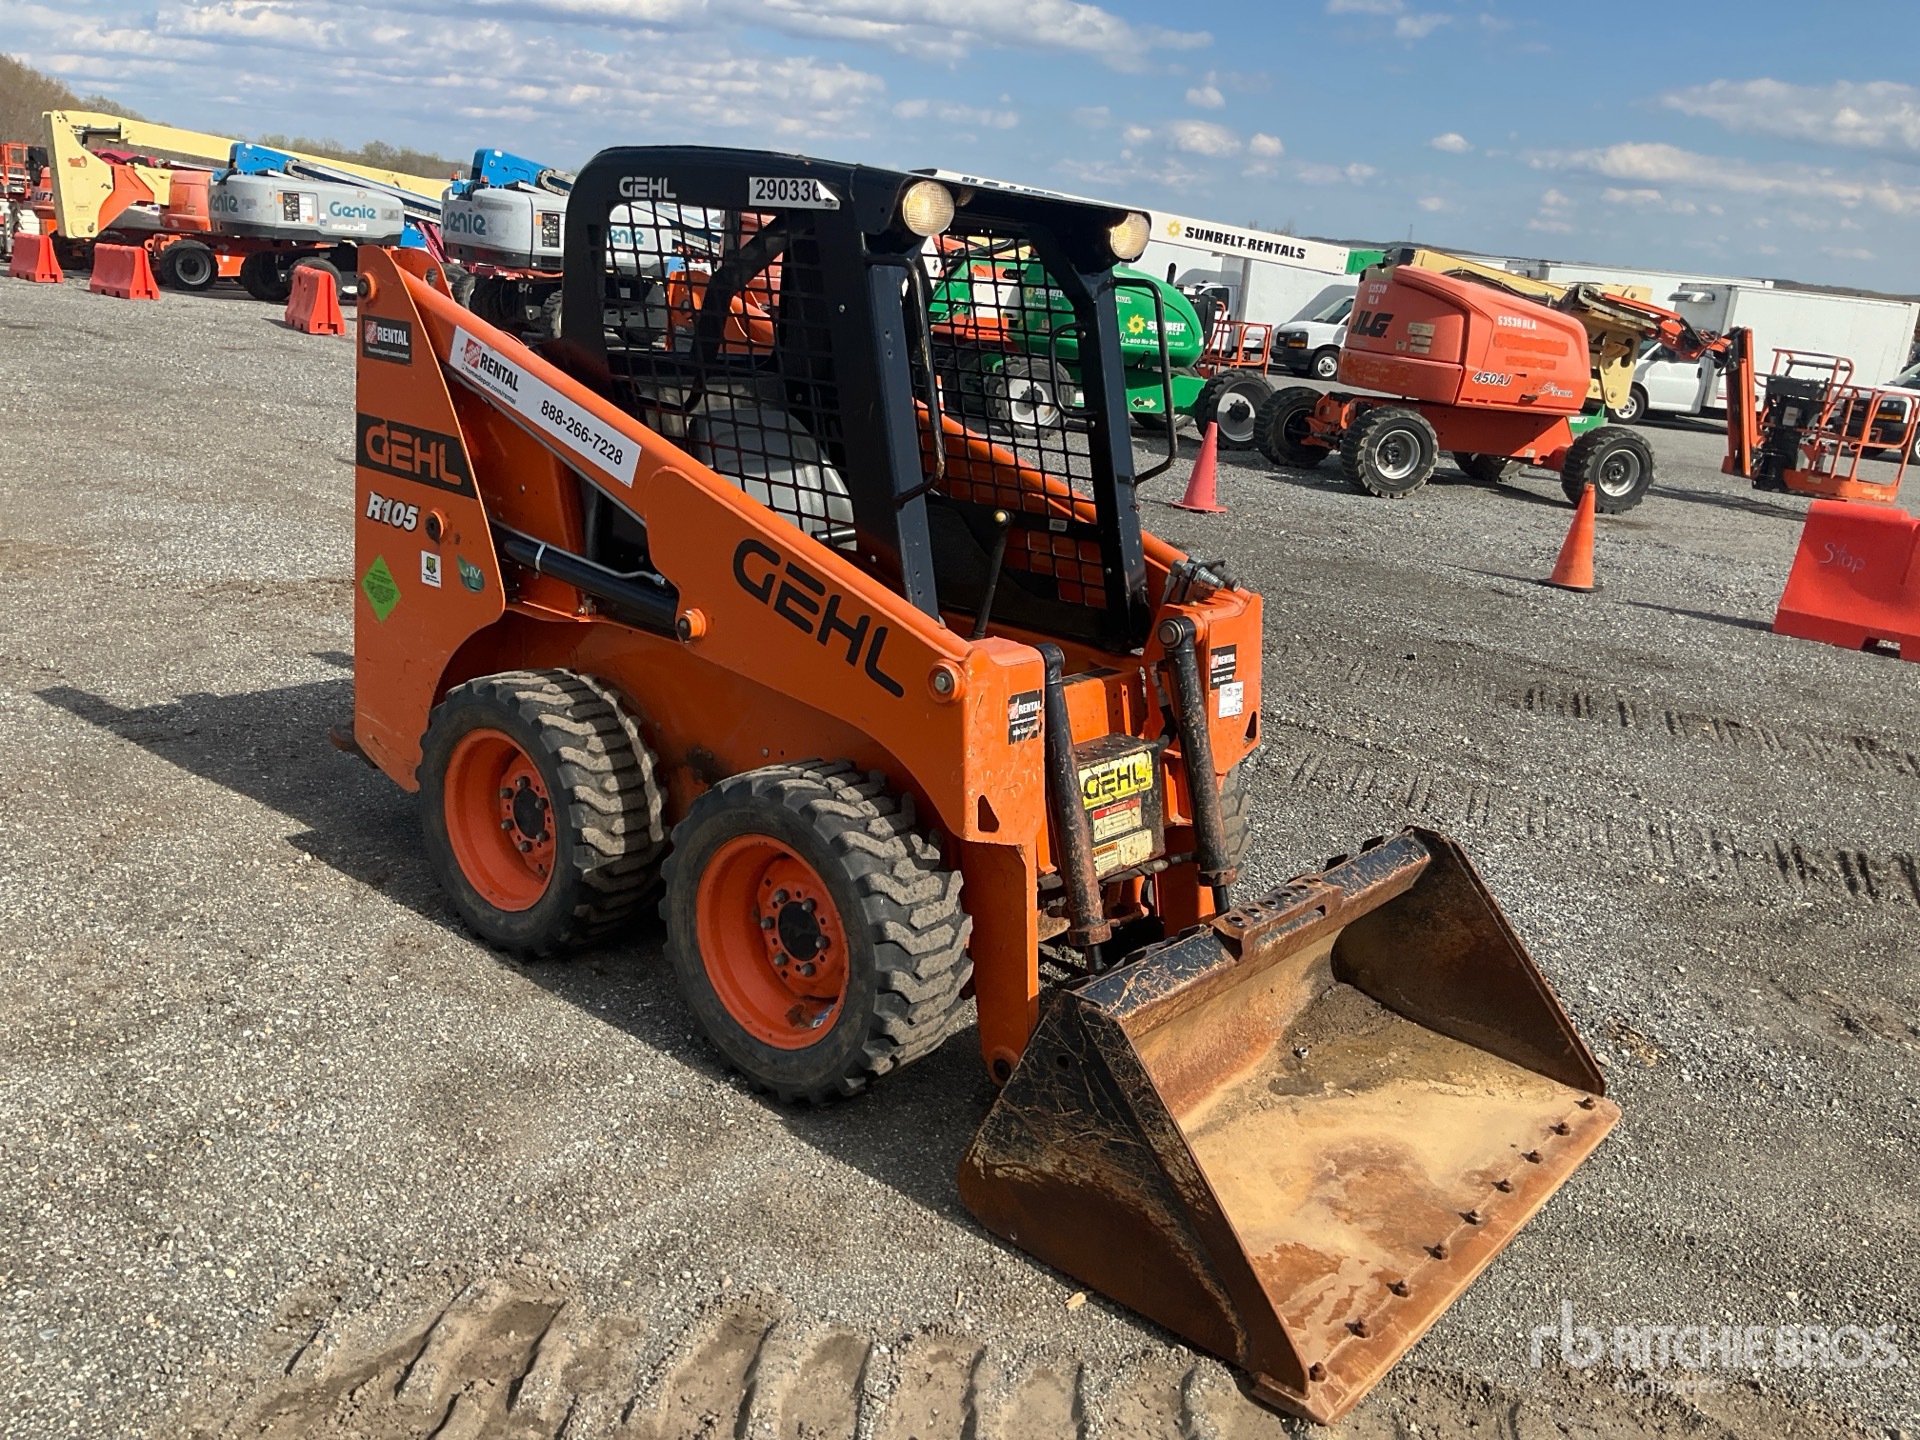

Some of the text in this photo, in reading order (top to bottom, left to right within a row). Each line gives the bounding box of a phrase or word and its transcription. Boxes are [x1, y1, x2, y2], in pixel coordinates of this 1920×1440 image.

[209, 190, 239, 213] enie
[619, 176, 677, 198] GEHL
[755, 178, 833, 203] 290336
[329, 200, 376, 220] Genie
[610, 229, 644, 245] enie
[1185, 226, 1306, 260] SUNBELT RENTALS
[377, 326, 409, 347] RENTAL
[1350, 309, 1395, 339] JLG
[480, 352, 519, 393] RENTAL
[1473, 371, 1513, 388] 450AJ
[540, 399, 624, 466] 888-266-7228
[365, 423, 462, 486] GEHL
[366, 491, 420, 532] R105
[1819, 542, 1867, 574] Stop
[732, 538, 905, 699] GEHL
[1083, 762, 1147, 800] GEHL
